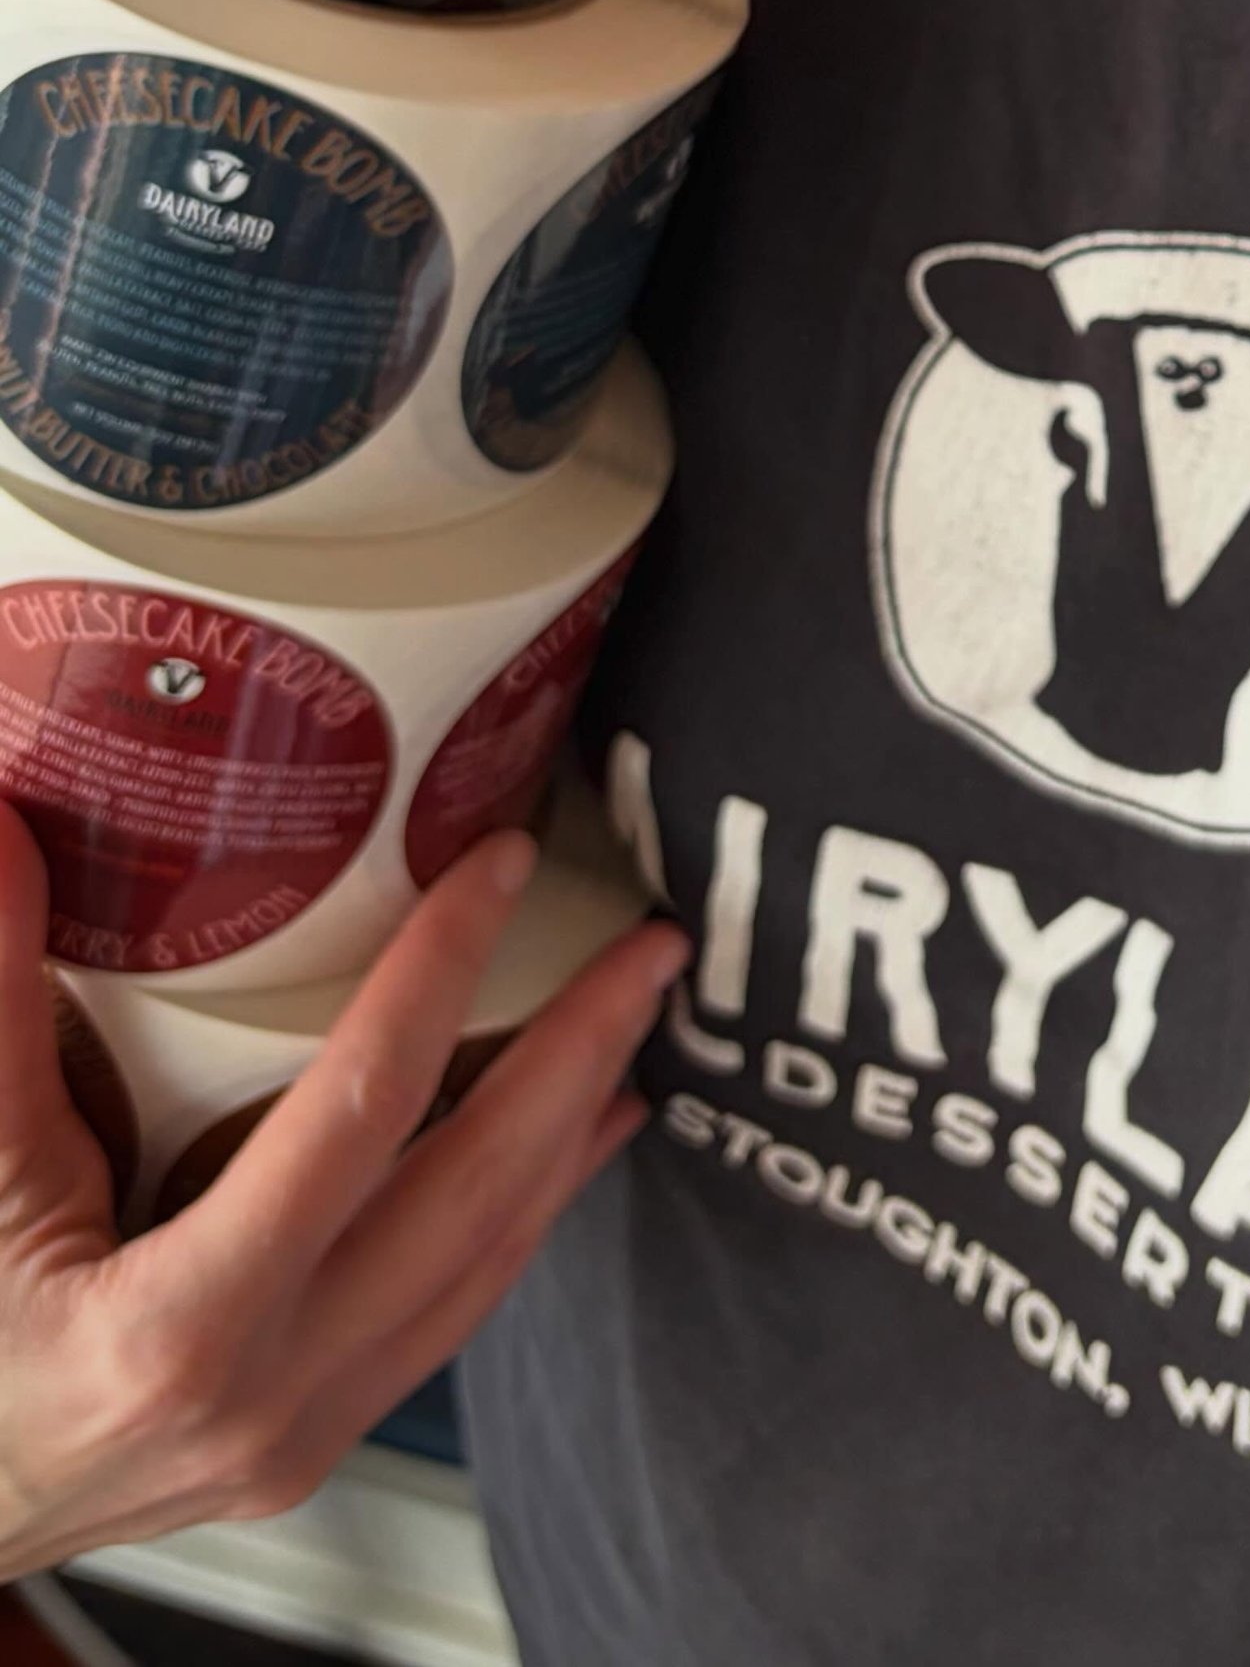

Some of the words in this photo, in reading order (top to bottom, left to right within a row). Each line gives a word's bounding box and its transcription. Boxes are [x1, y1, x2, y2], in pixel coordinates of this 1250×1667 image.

[37, 68, 316, 162] CHEESECAKE
[302, 125, 430, 240] BOMB
[29, 407, 152, 496] BUTTER
[157, 465, 184, 502] &
[2, 589, 258, 666] CHEESECAKE
[254, 634, 375, 731] BOMB
[189, 882, 310, 959] LEMON
[660, 1090, 1131, 1419] STOUGHTON,
